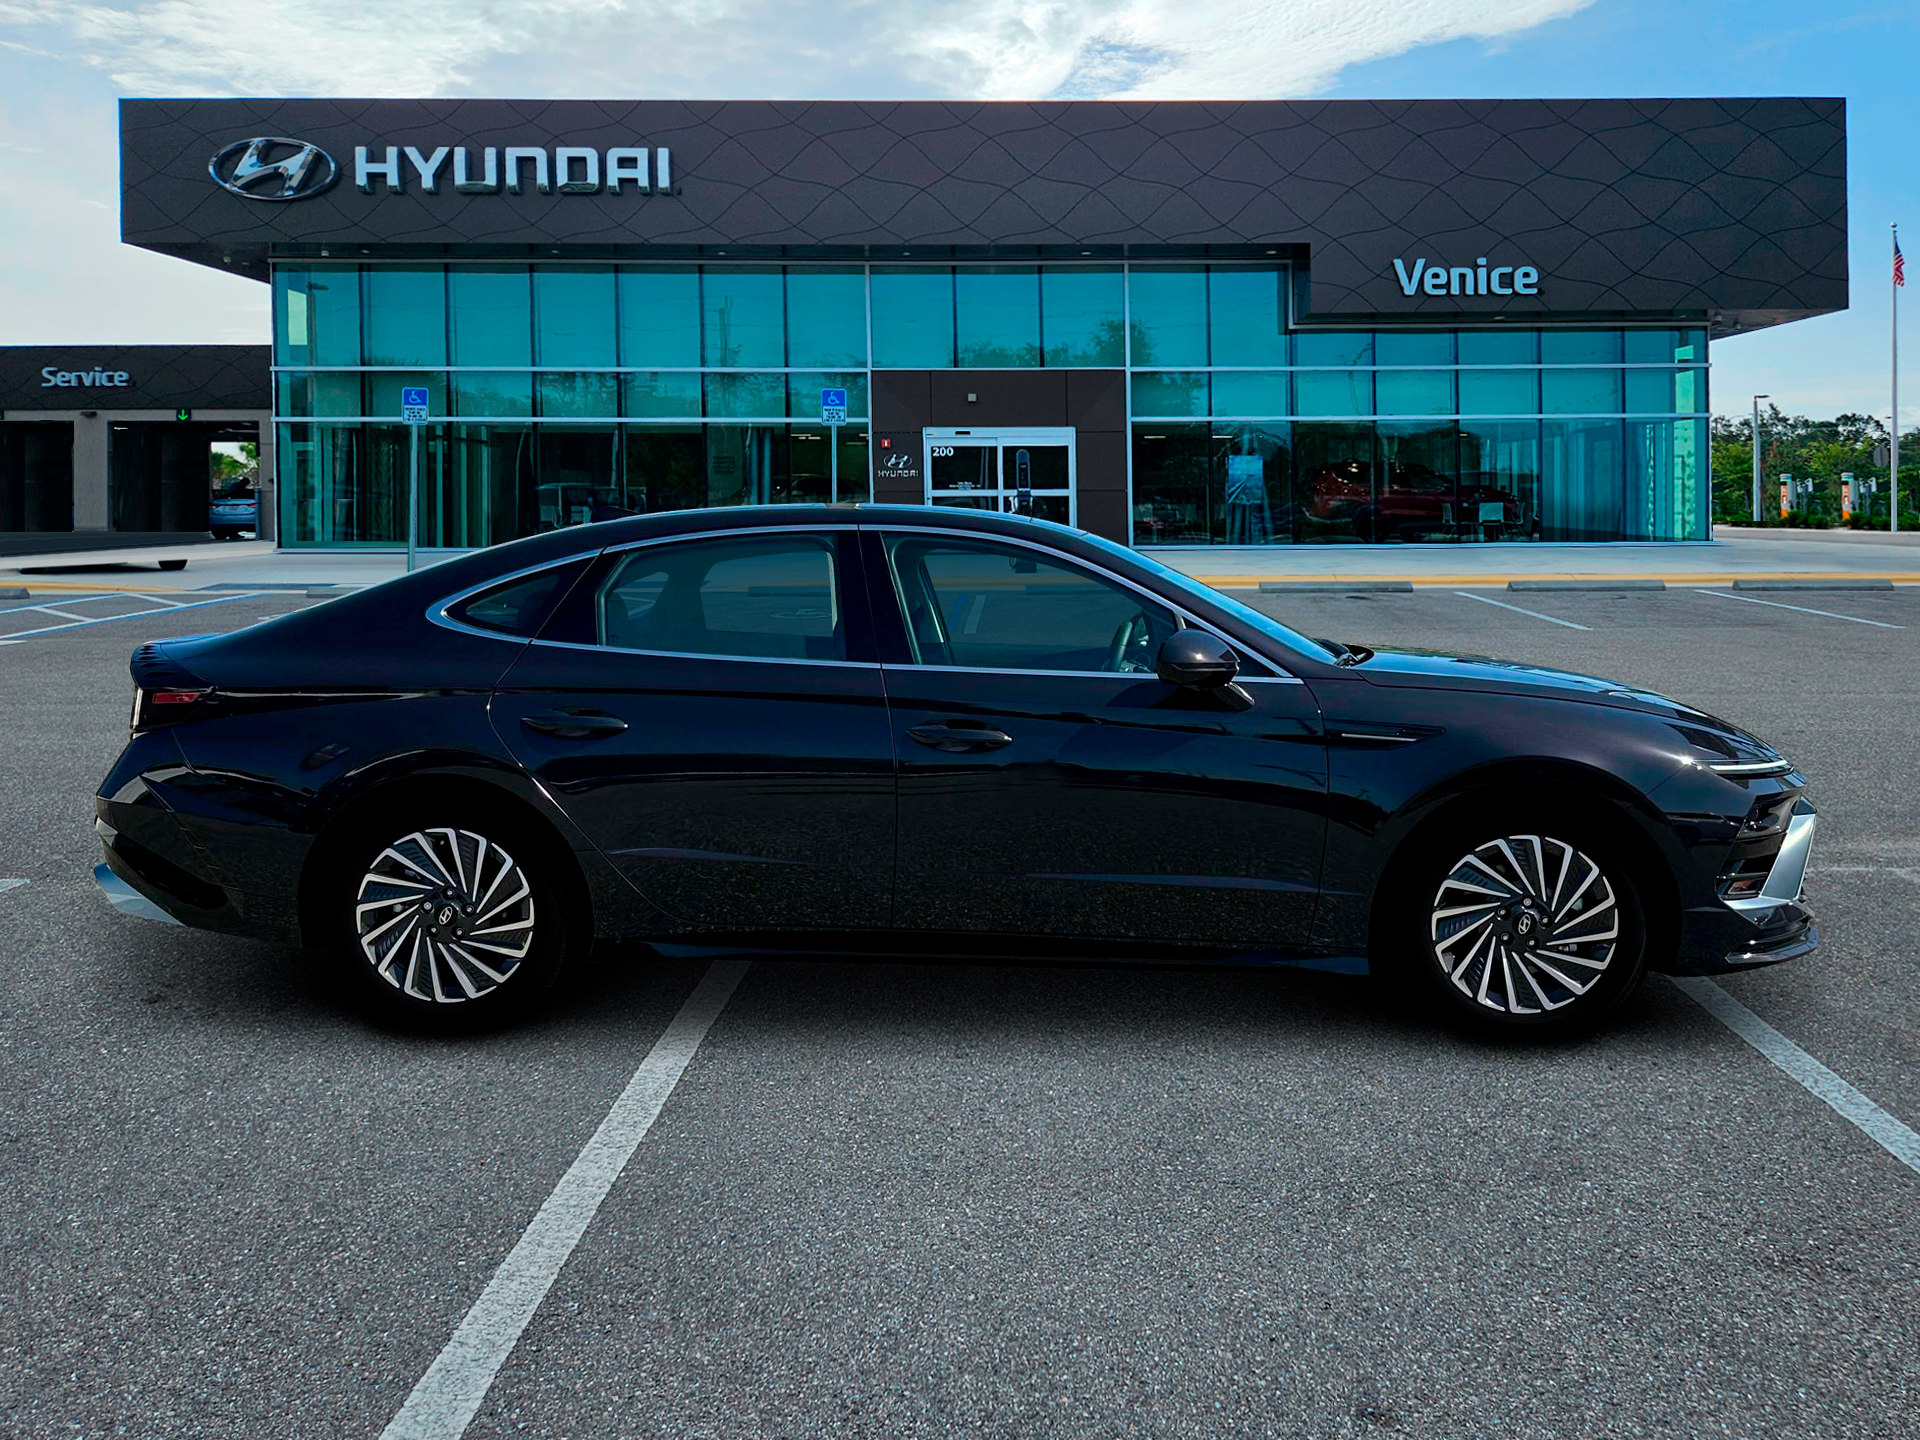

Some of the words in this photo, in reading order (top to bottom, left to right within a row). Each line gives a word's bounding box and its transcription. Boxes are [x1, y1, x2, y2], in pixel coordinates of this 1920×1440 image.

[353, 146, 671, 194] HYUNDAI
[1393, 257, 1539, 296] Venice
[41, 366, 130, 387] Service
[932, 446, 954, 457] 200
[877, 469, 919, 478] HYUNDAI
